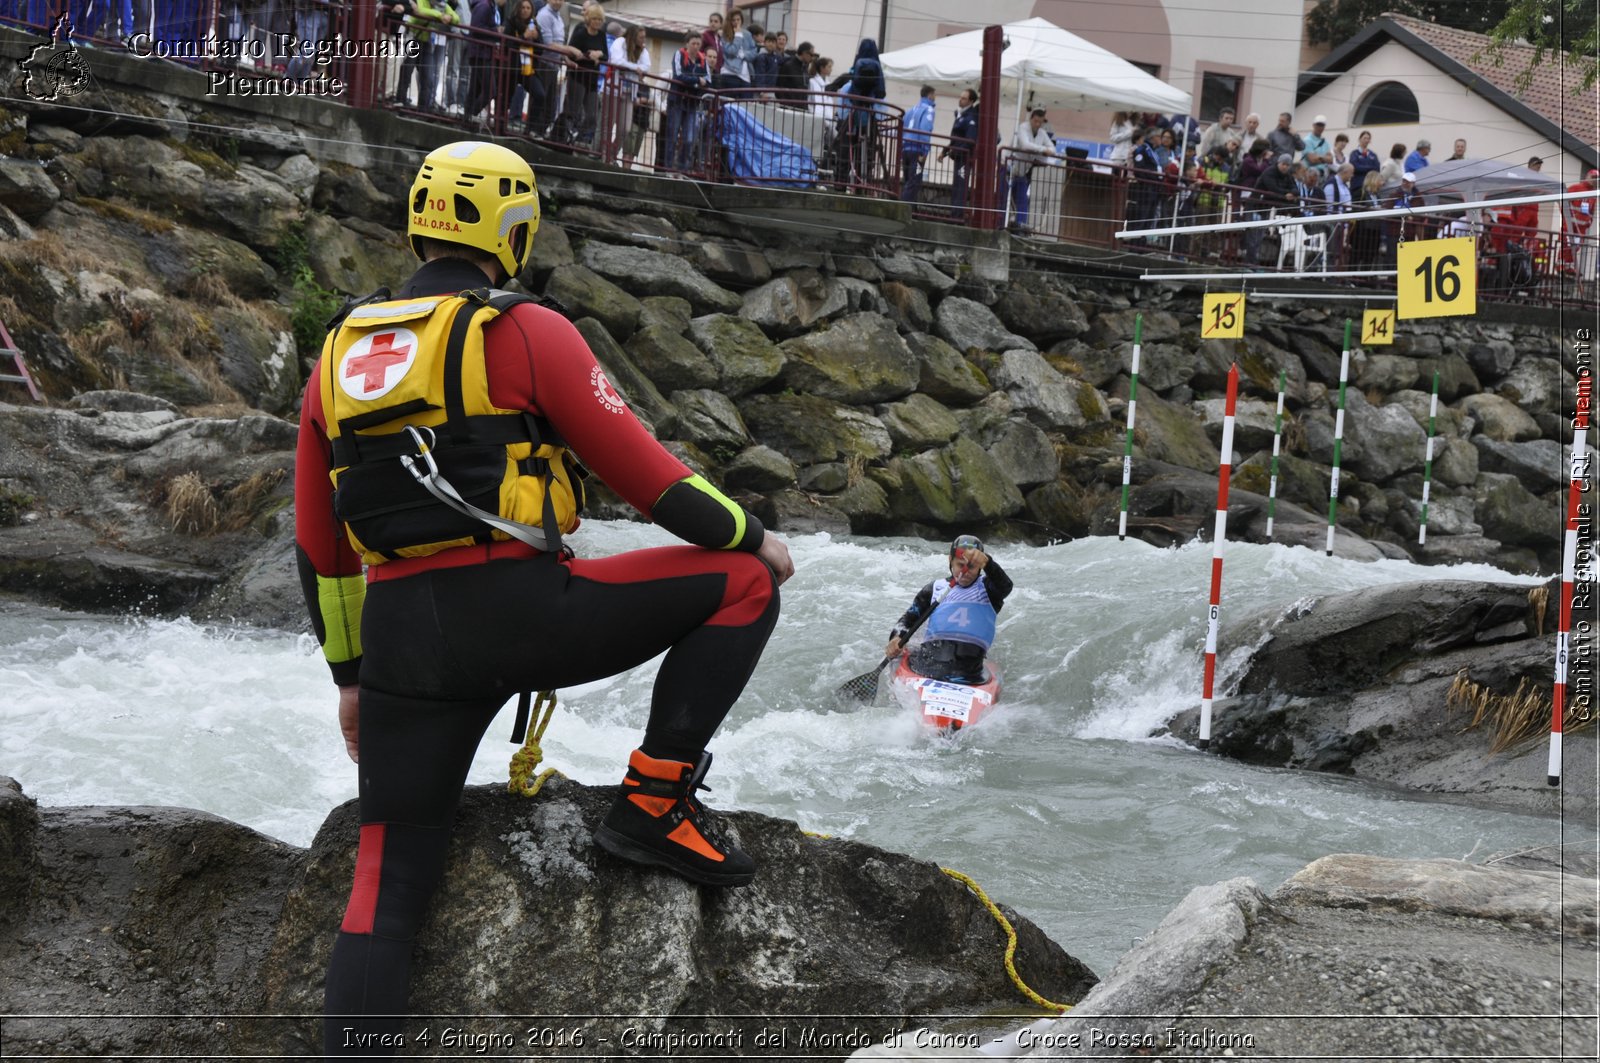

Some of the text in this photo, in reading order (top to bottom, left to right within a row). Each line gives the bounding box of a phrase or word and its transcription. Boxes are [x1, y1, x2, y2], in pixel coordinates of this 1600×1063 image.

[429, 198, 446, 212] 10
[431, 220, 462, 233] O.P.S.A.
[1414, 254, 1461, 303] 16
[1211, 302, 1236, 330] 15
[1368, 316, 1388, 338] 14
[590, 365, 624, 415] CROCE ROSS
[947, 606, 971, 628] 4
